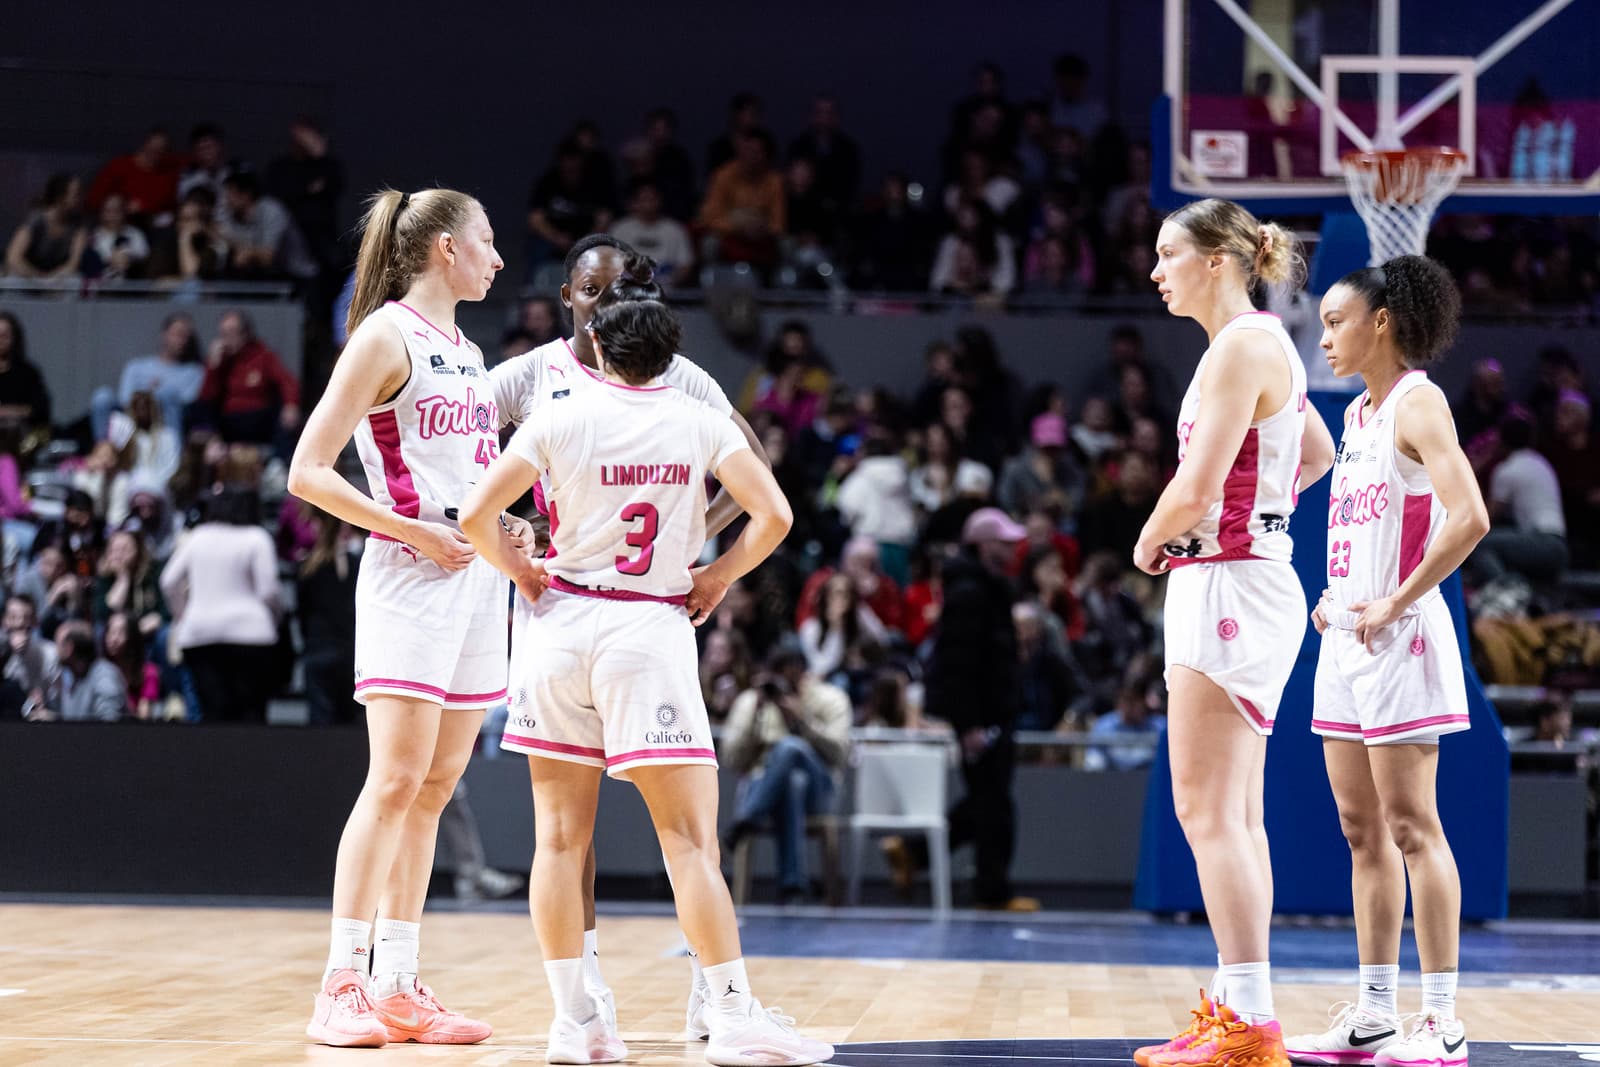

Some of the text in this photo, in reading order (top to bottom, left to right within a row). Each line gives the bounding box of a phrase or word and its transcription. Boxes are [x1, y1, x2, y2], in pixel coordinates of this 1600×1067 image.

[600, 464, 691, 486] LIMOUZIN
[615, 502, 659, 577] 3
[1329, 540, 1351, 578] 23
[645, 730, 692, 744] Calicéo
